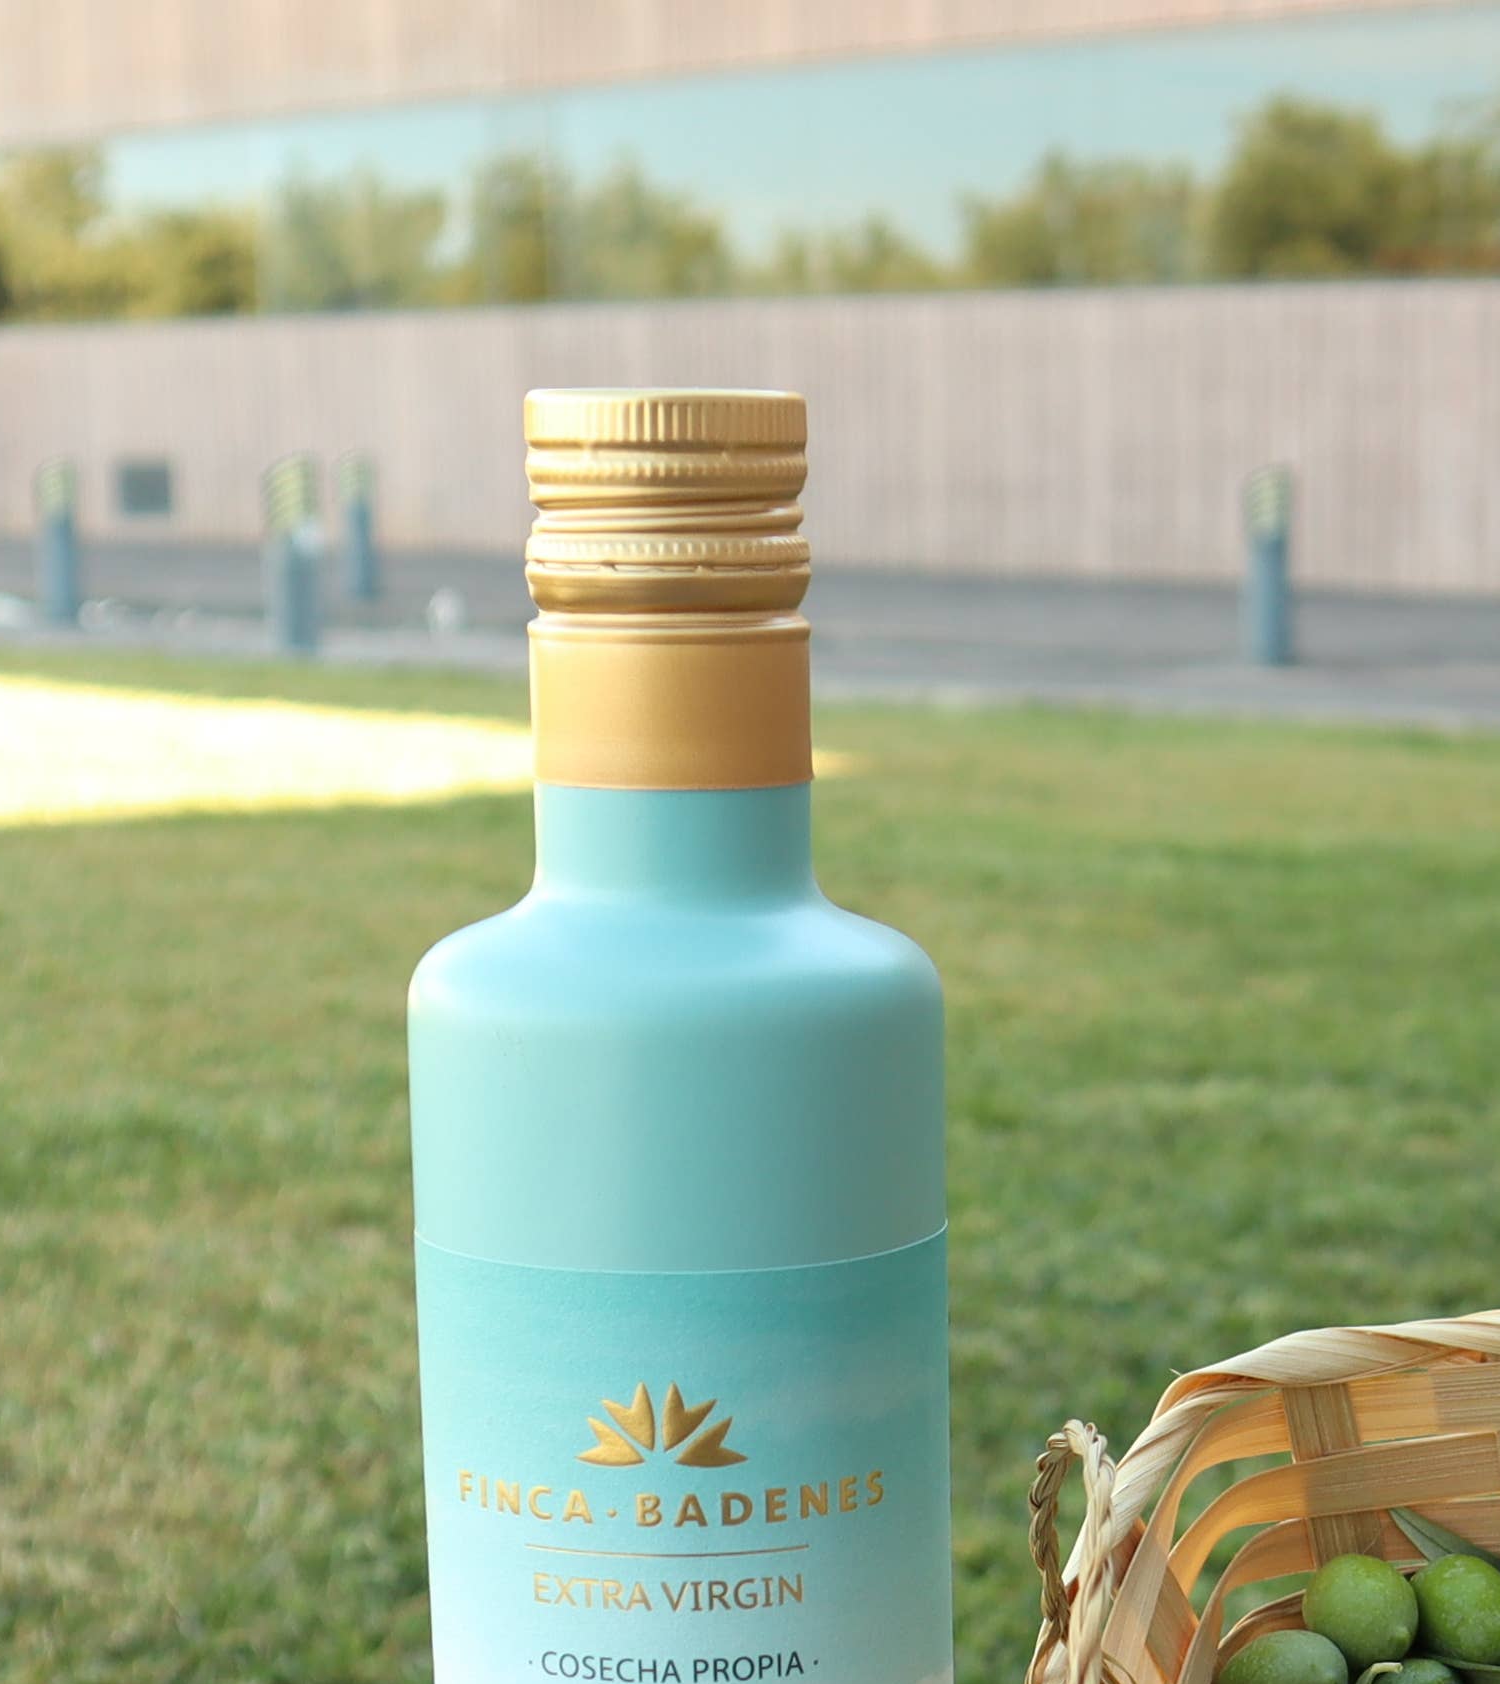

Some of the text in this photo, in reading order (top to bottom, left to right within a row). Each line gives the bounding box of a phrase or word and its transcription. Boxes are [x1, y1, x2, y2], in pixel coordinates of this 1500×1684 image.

[457, 1468, 885, 1528] FINCA BADENES
[532, 1572, 804, 1612] EXTRA VIRGIN
[541, 1650, 804, 1683] COSECHA PROPIA
